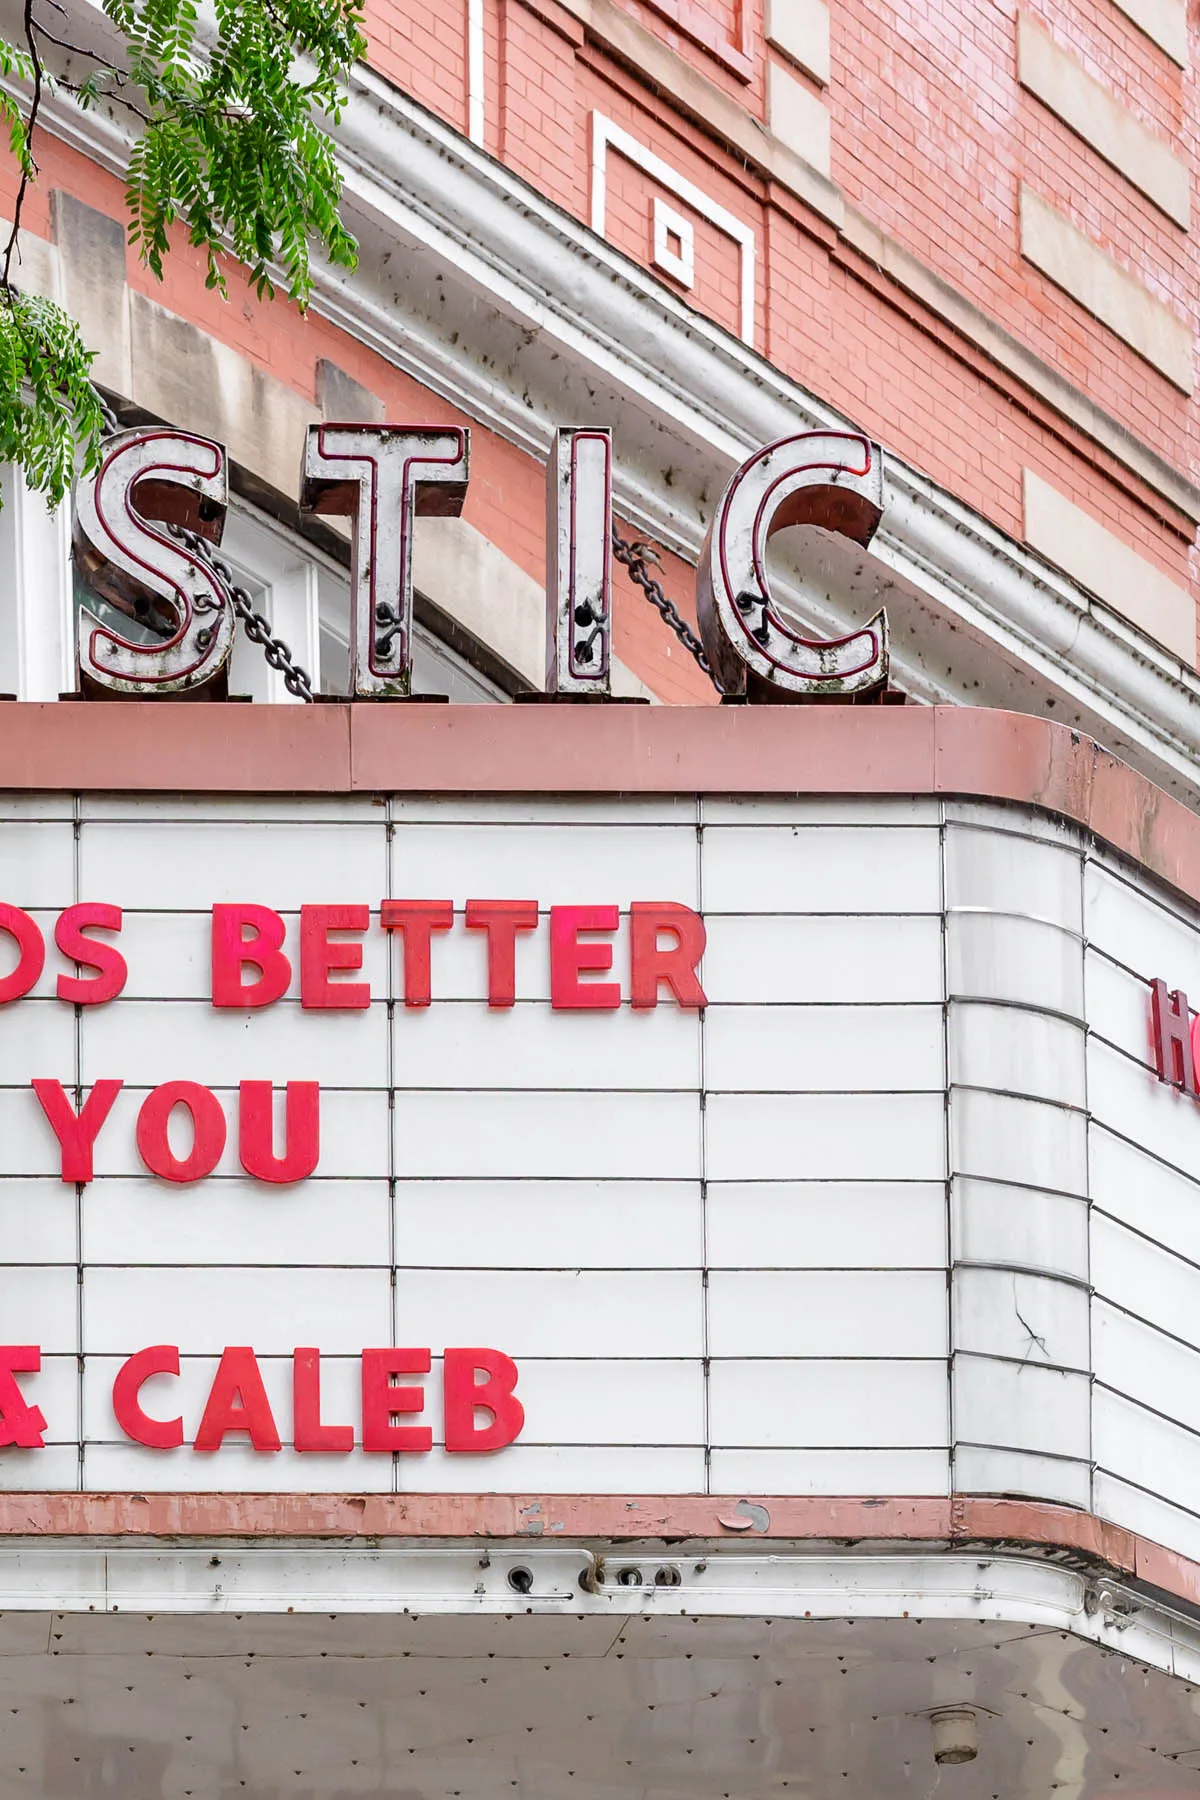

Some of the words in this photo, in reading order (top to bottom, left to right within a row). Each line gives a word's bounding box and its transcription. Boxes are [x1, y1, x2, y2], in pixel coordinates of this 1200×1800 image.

[211, 898, 710, 1010] BETTER
[31, 1078, 320, 1185] YOU
[112, 1344, 525, 1453] CALEB
